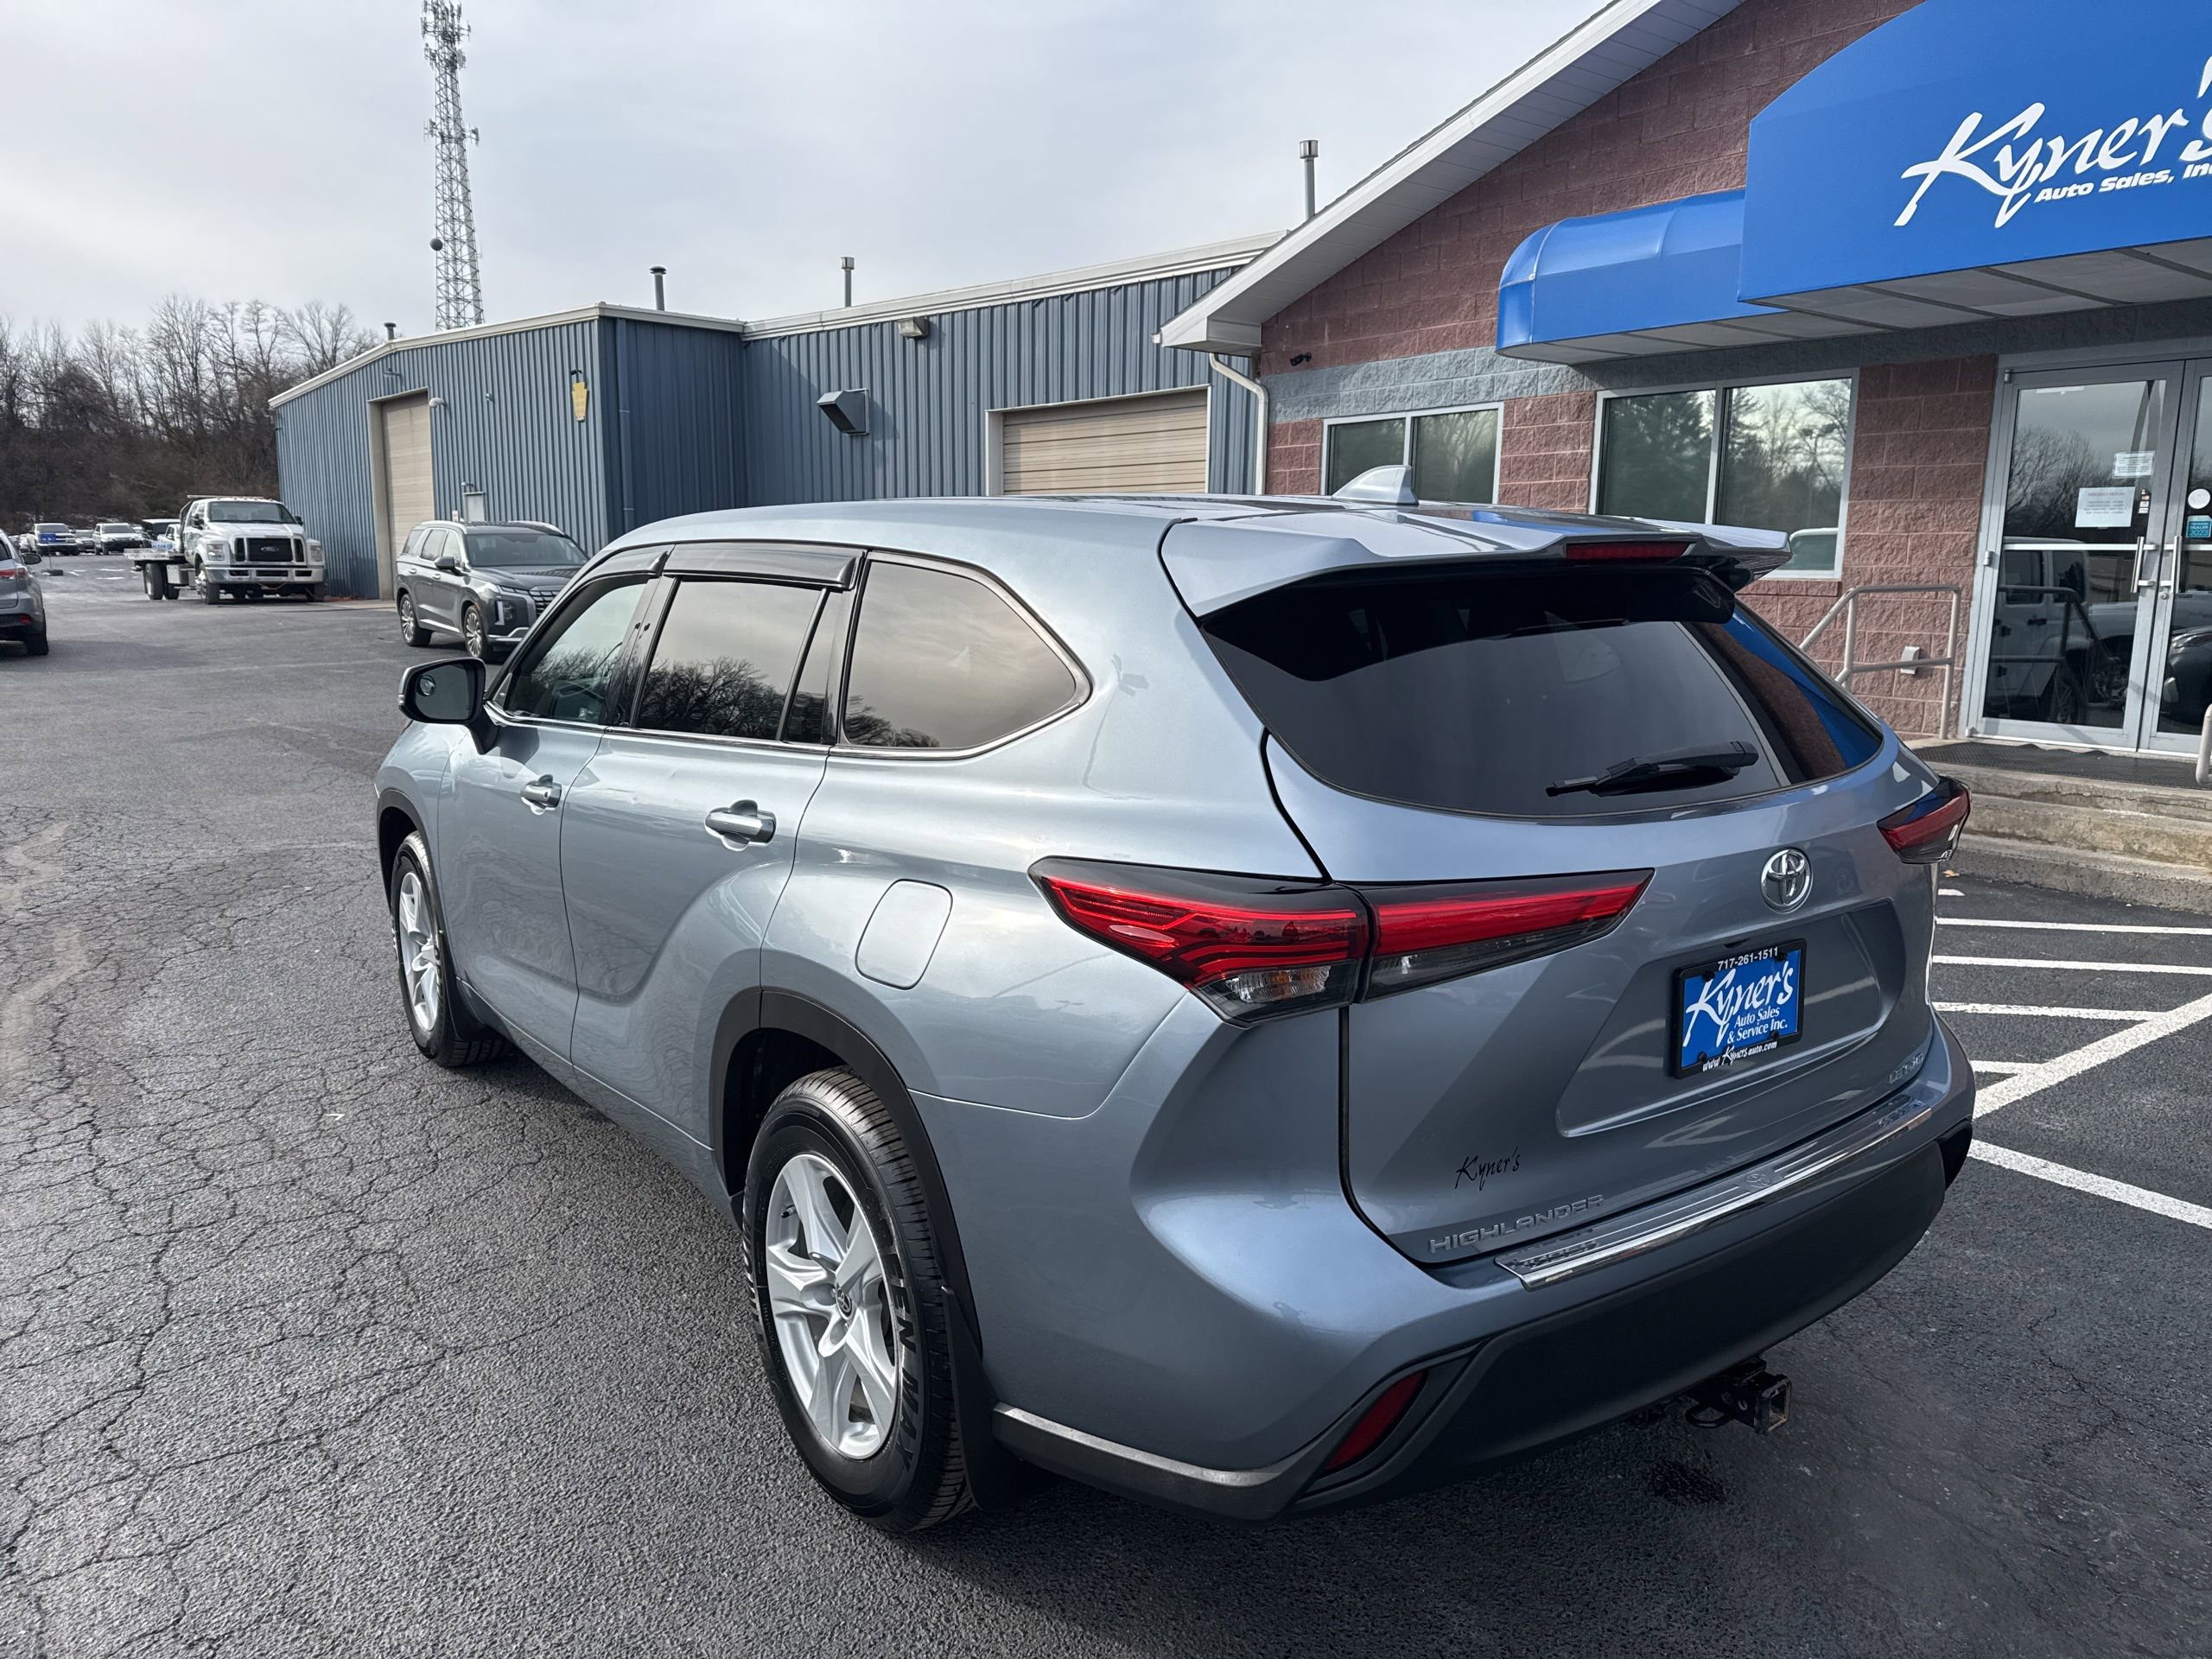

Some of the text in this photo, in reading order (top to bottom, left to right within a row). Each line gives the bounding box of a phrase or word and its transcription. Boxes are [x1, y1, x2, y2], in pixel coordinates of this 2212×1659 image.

[2033, 182, 2094, 204] Auto
[2099, 169, 2175, 194] Sales,
[1718, 947, 1778, 970] 717-261-1511
[1682, 961, 1794, 1048] Kyner's
[1734, 1006, 1780, 1028] Auto Sales
[1726, 1017, 1789, 1044] & Service Inc.
[1454, 1147, 1521, 1192] Kyner's
[1428, 1194, 1605, 1254] HIGHLANDER
